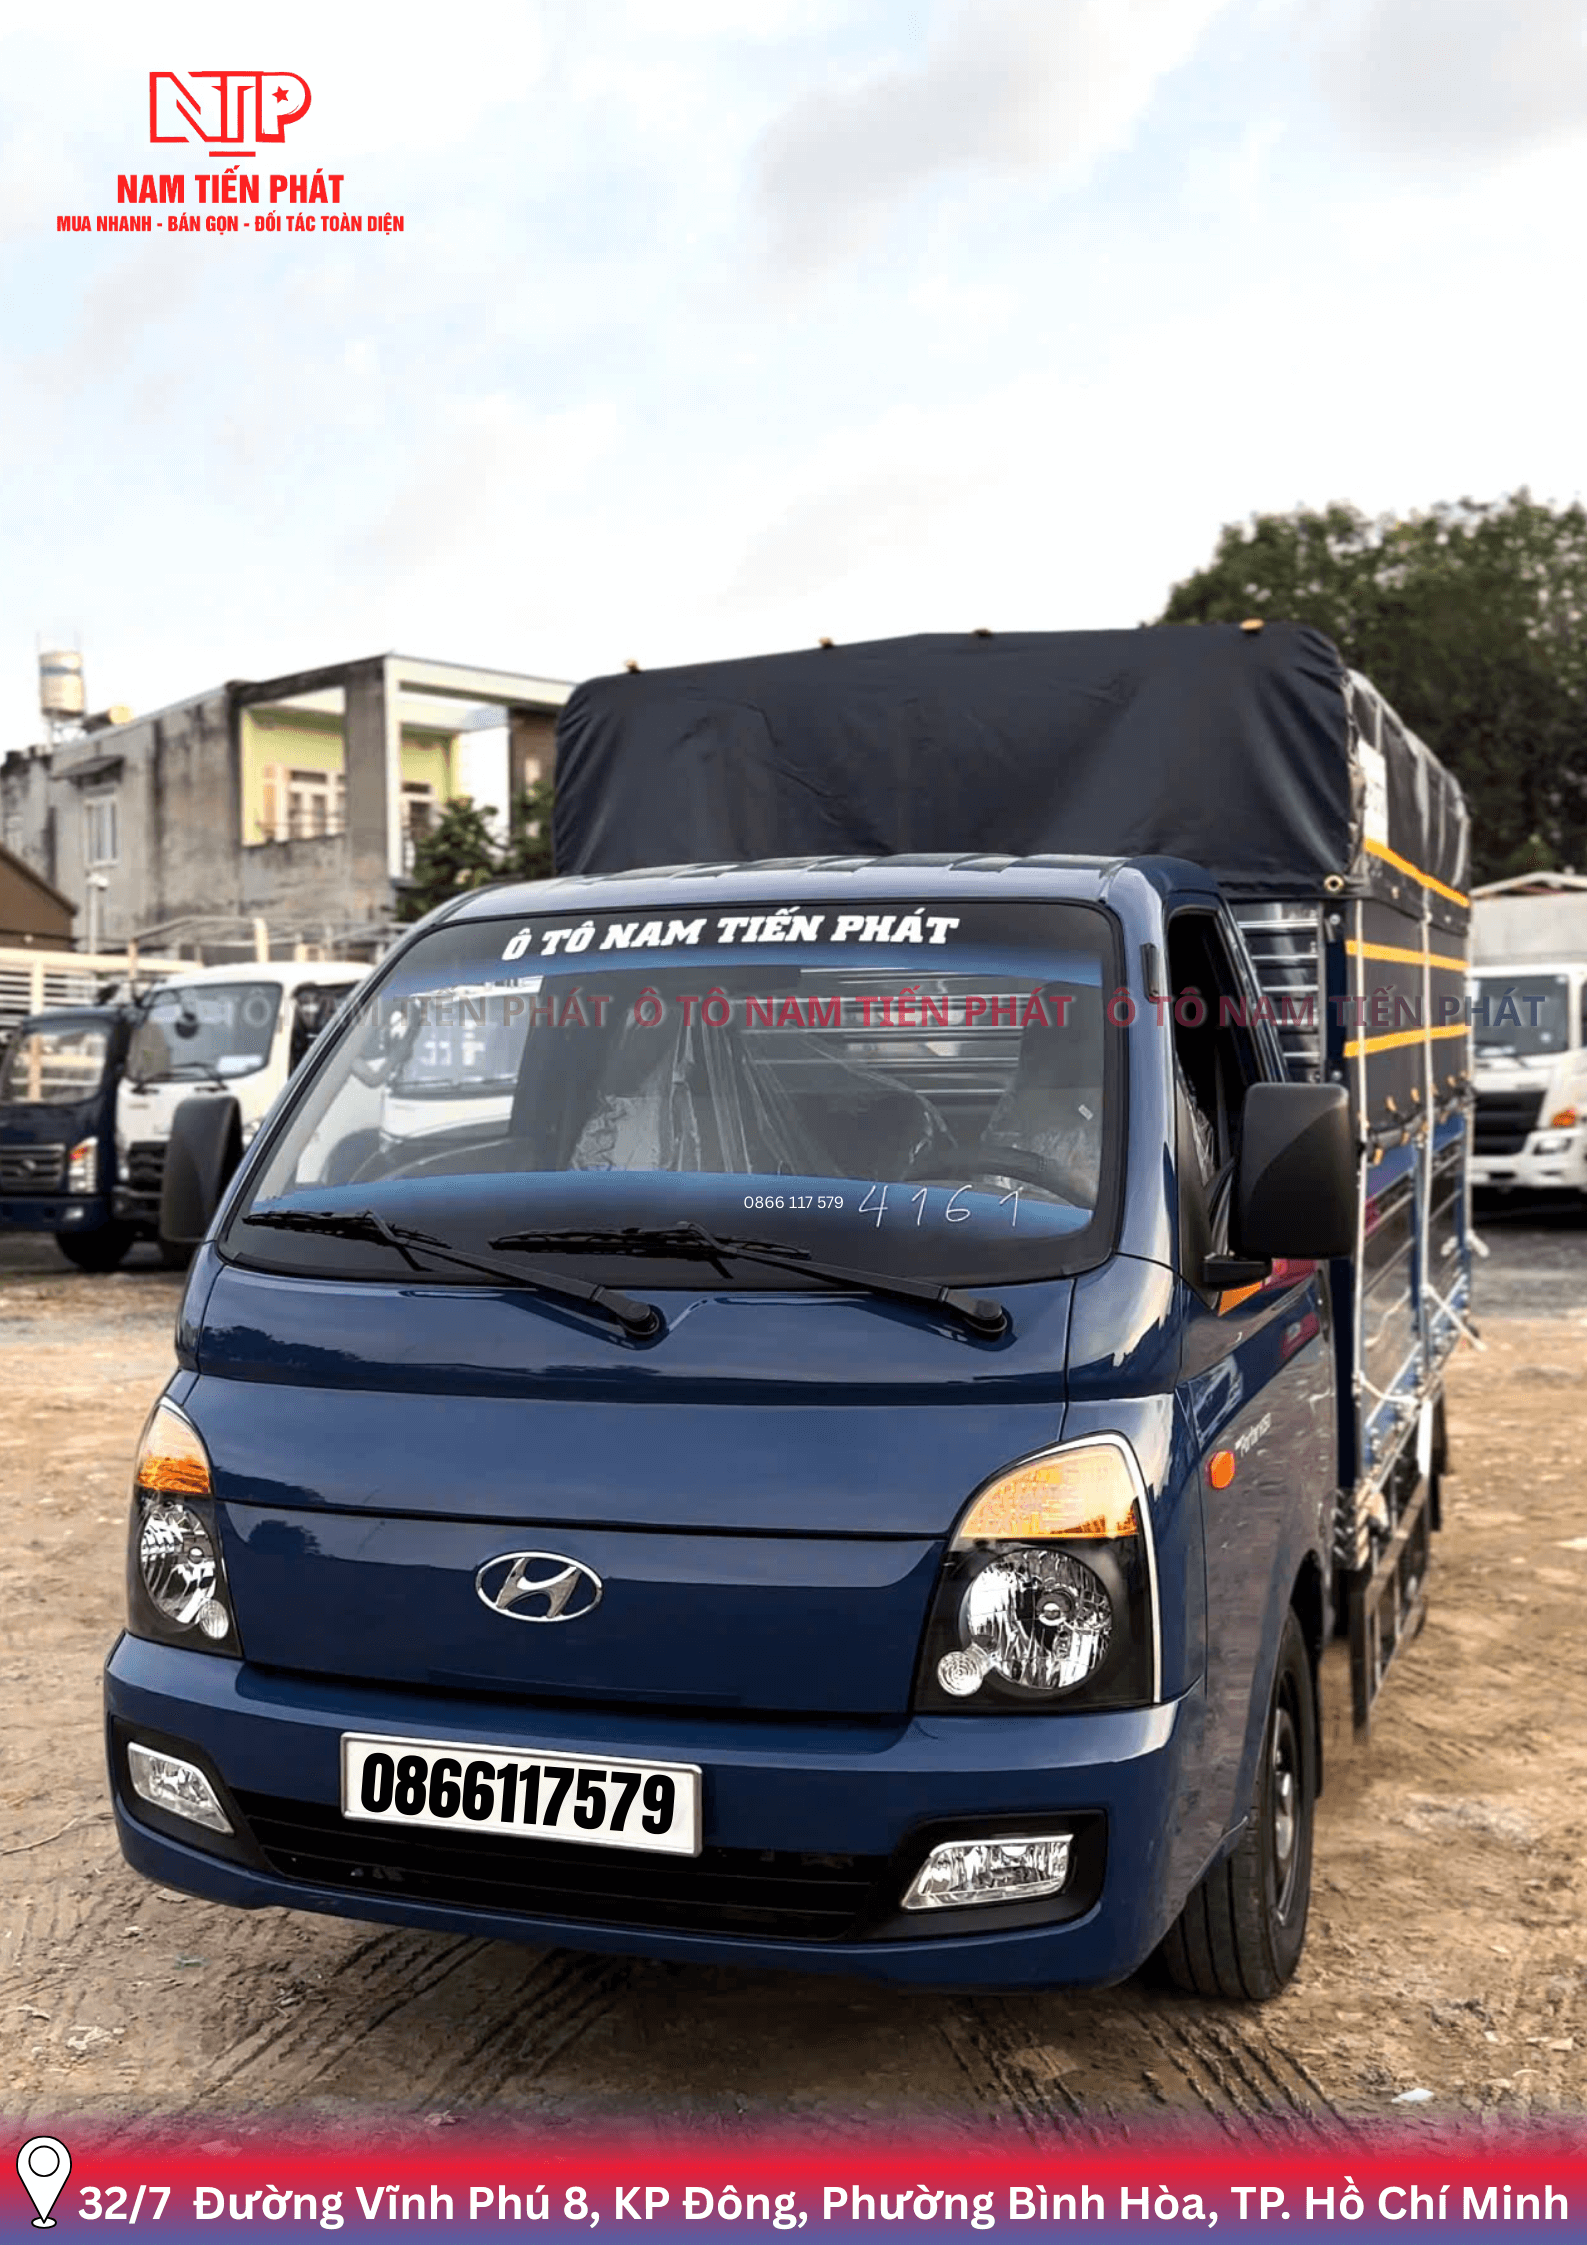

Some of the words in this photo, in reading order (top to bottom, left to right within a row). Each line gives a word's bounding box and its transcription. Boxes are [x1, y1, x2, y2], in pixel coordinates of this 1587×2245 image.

[501, 928, 532, 961] Ô
[541, 920, 596, 956] TÔ
[599, 918, 707, 950] NAM
[717, 906, 825, 943] TIẾN
[830, 907, 960, 944] PHÁT
[360, 1752, 676, 1835] 0866117579
